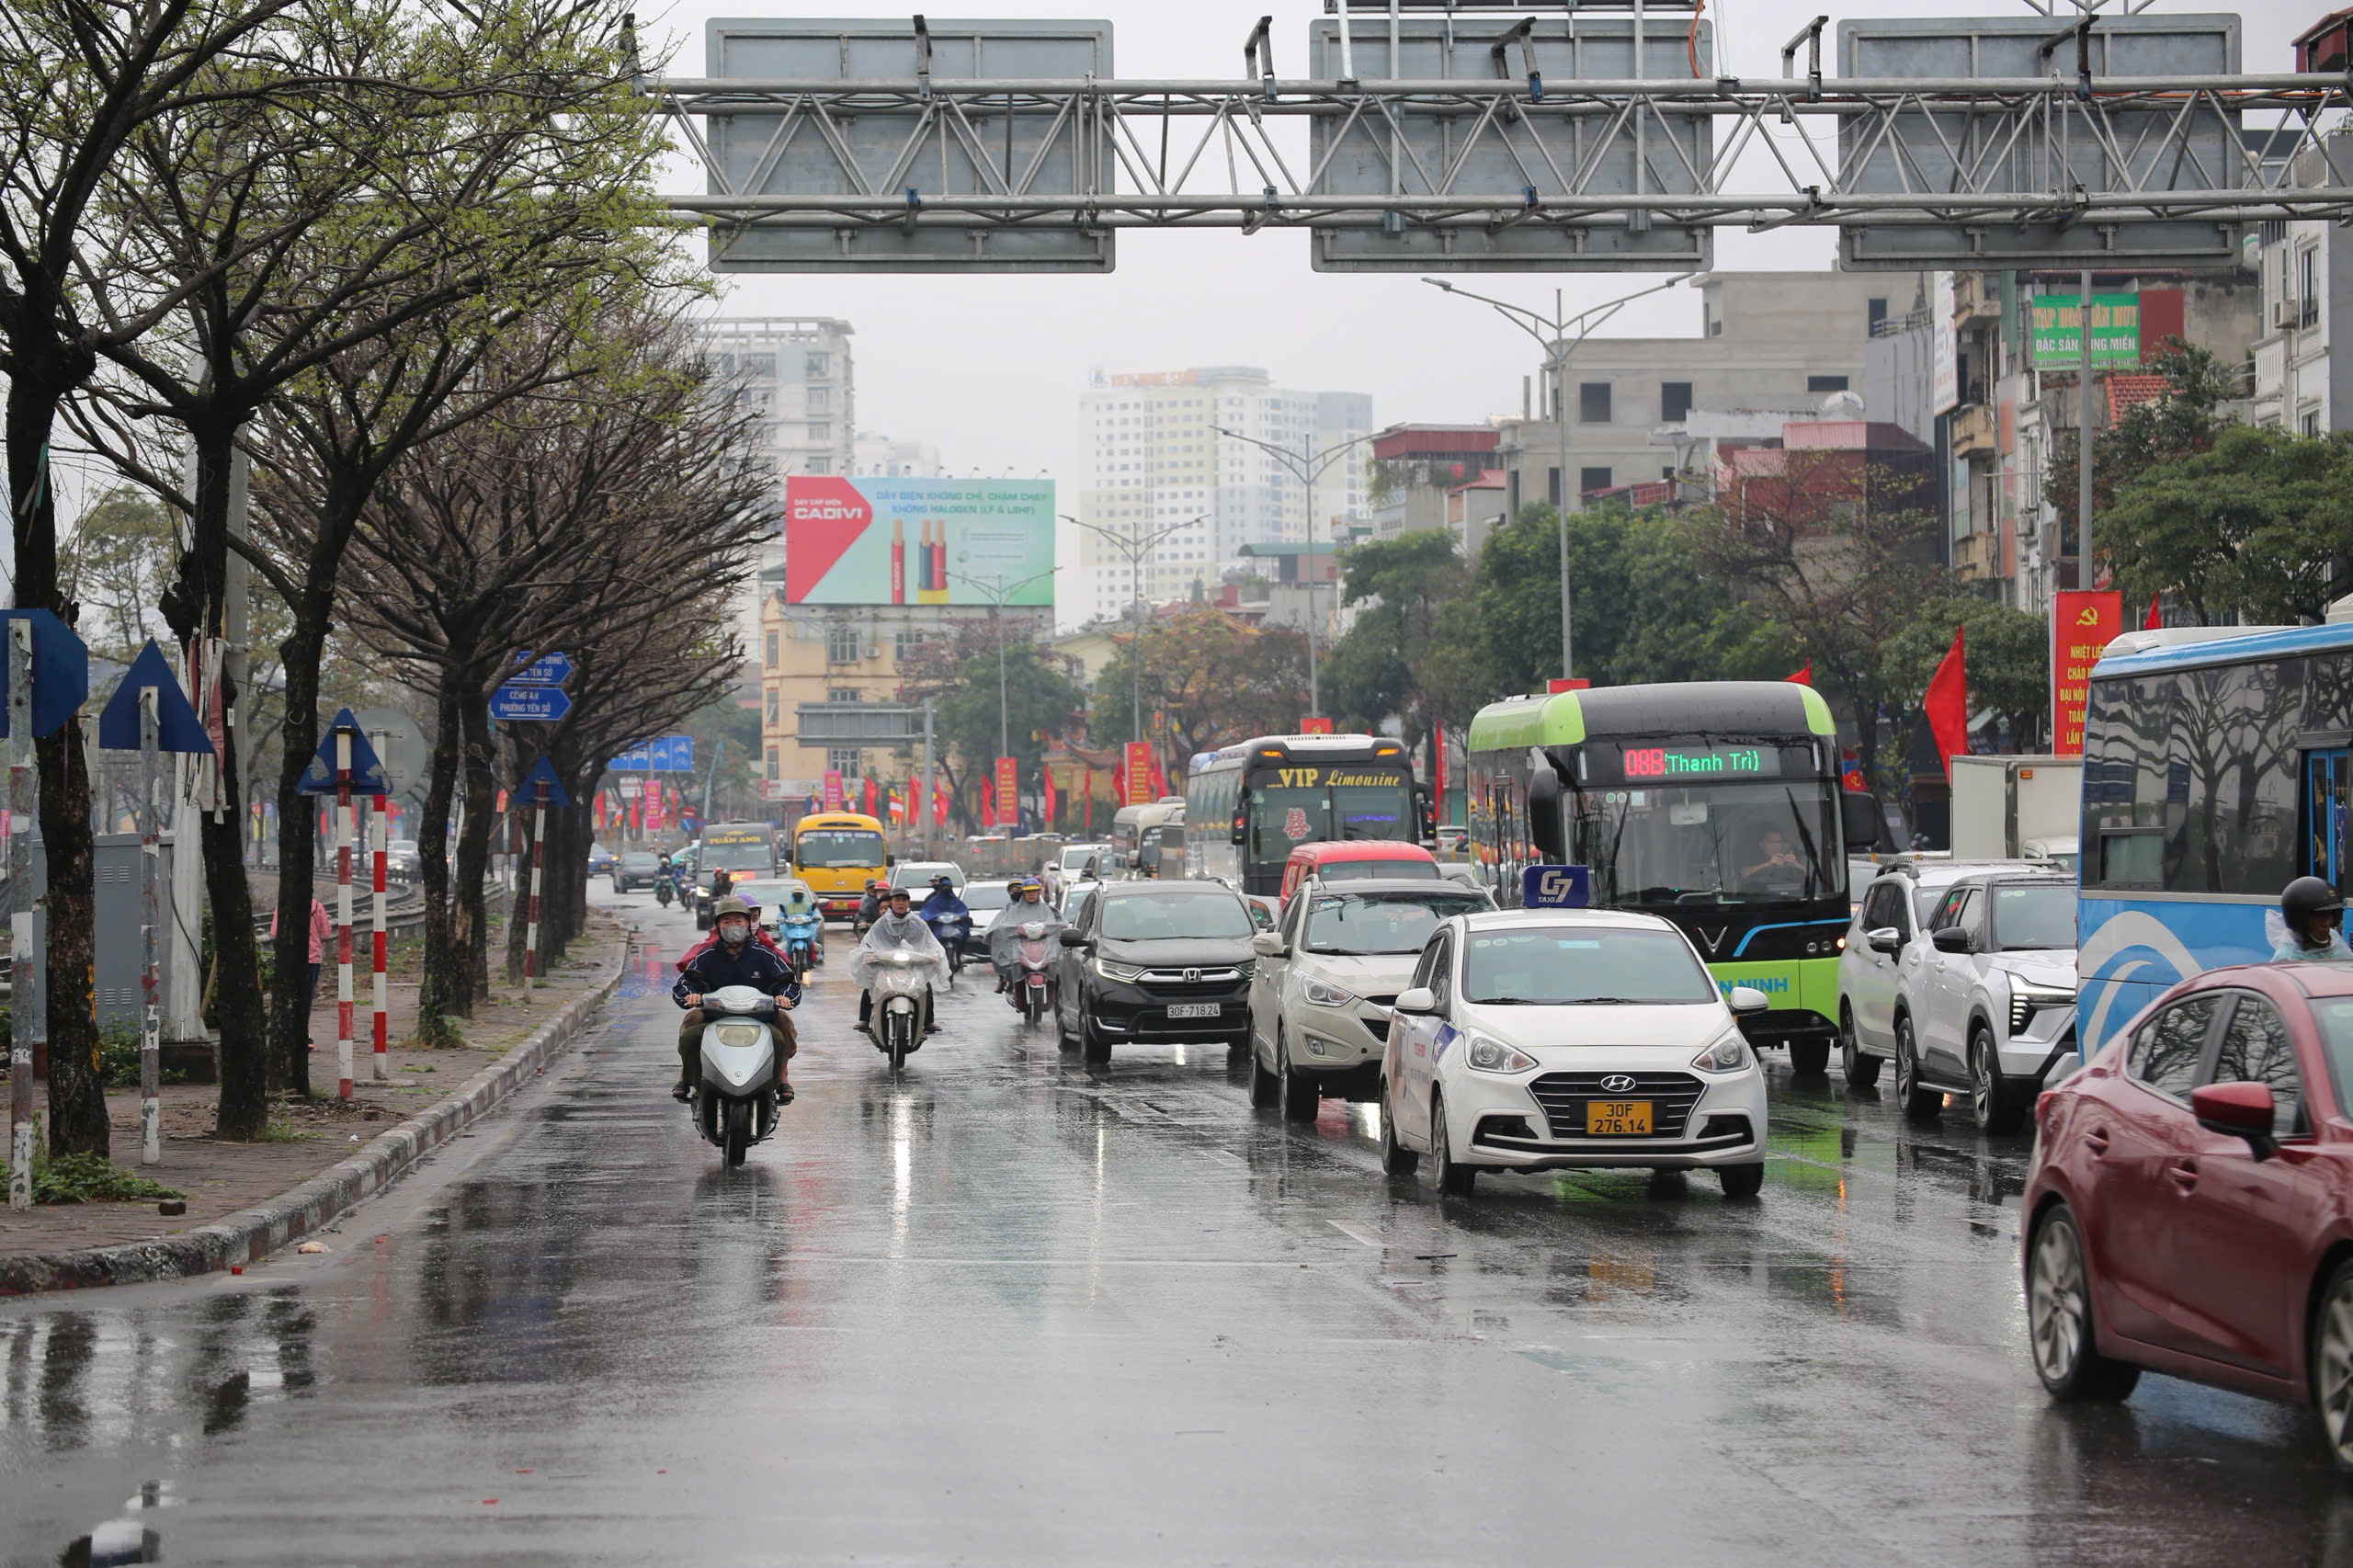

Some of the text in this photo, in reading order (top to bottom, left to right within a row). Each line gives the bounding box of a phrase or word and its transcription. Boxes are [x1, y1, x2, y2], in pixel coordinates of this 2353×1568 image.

[793, 506, 863, 520] CADIVI
[1625, 747, 1665, 778] 08B
[1279, 767, 1401, 788] VIP Limousine
[1540, 869, 1574, 903] G7
[1167, 1005, 1220, 1017] 30F-718.24
[1606, 1103, 1634, 1118] 30F
[1595, 1119, 1646, 1133] 276.14
